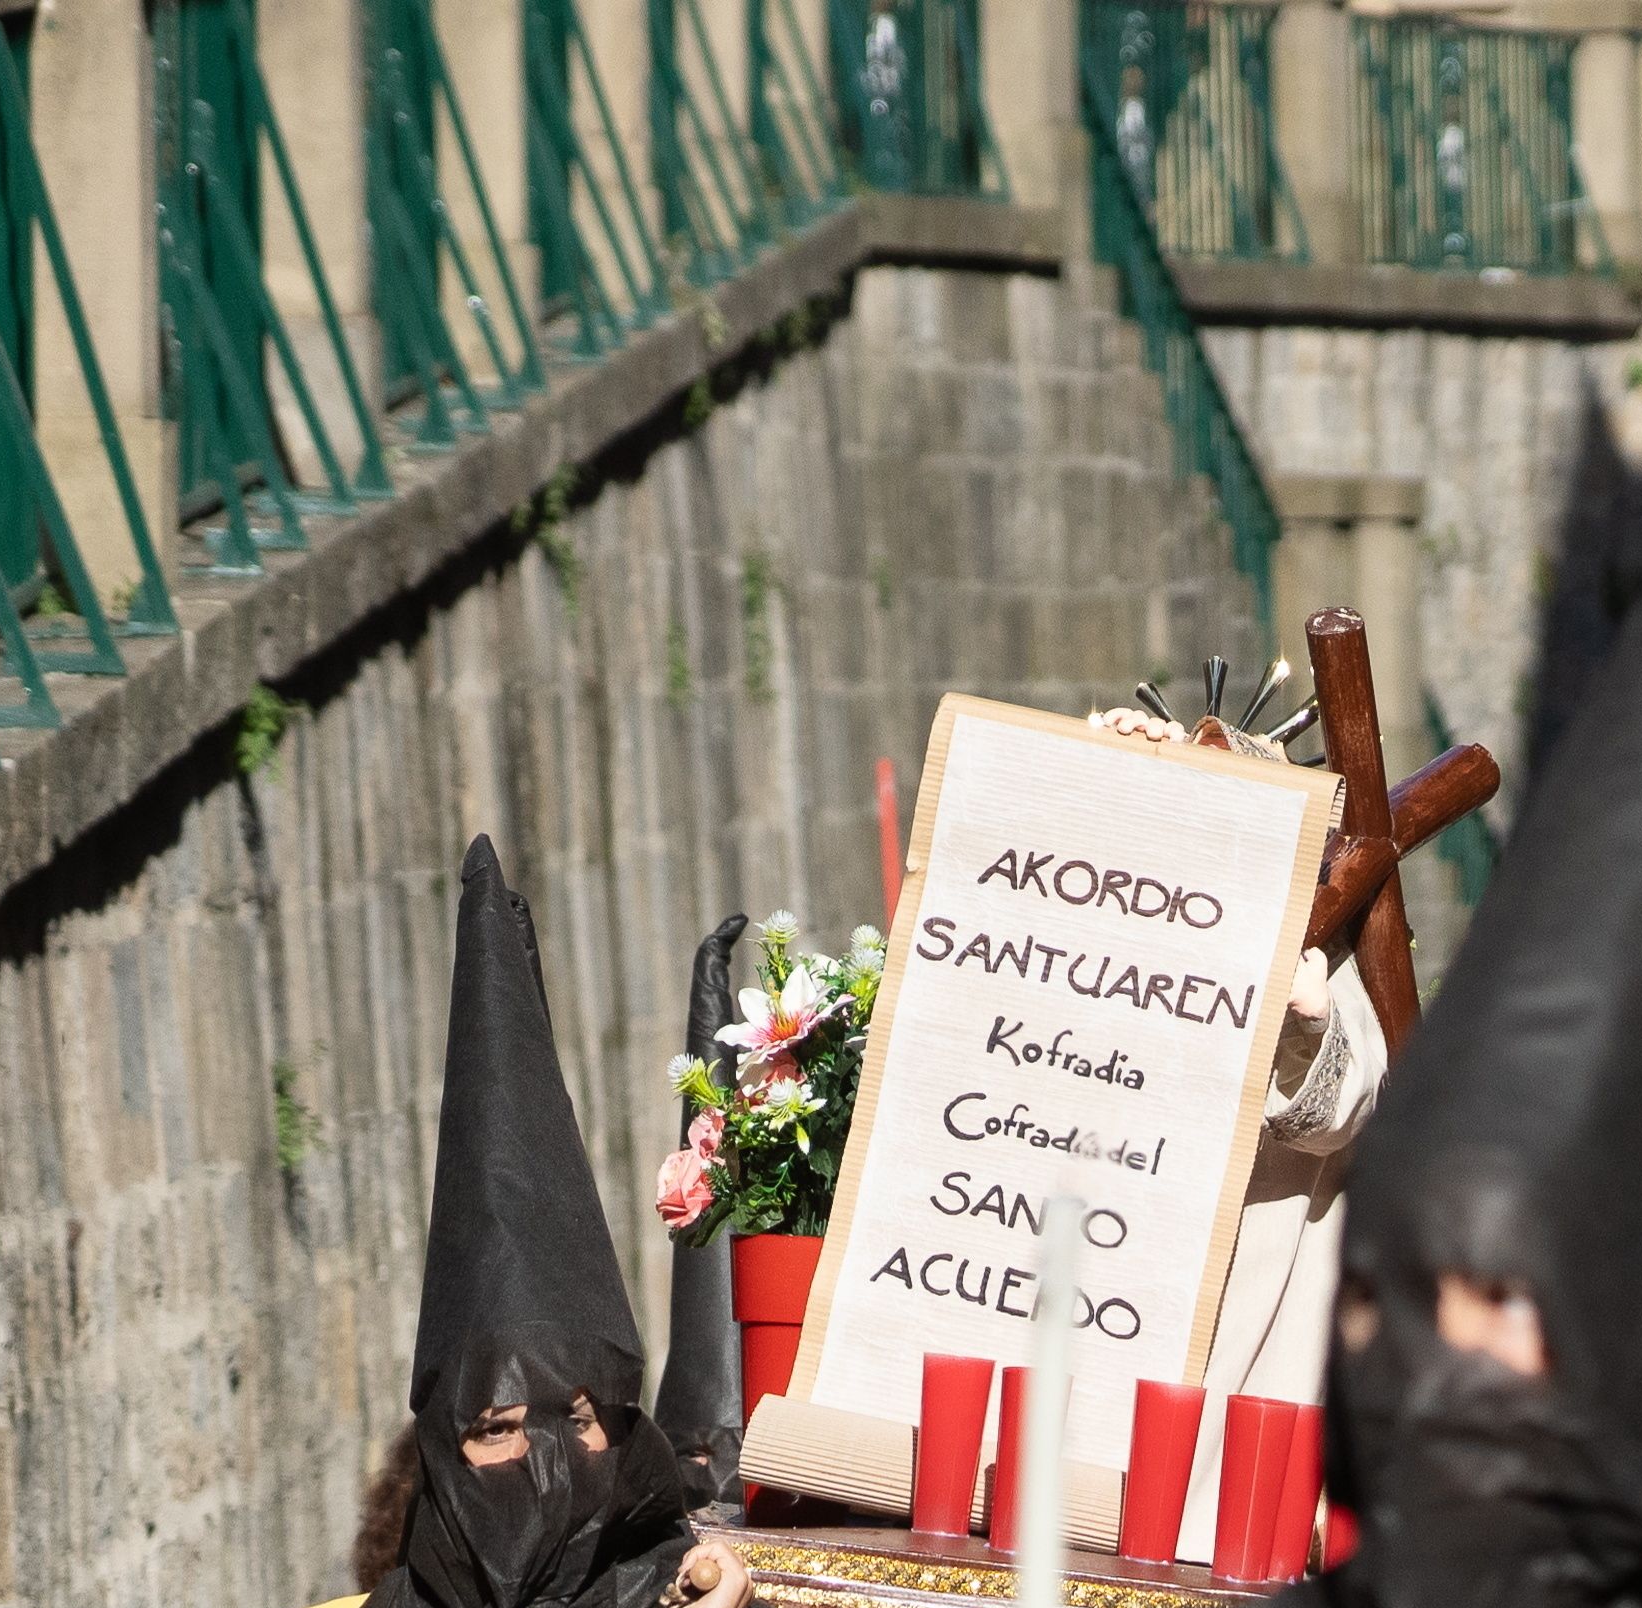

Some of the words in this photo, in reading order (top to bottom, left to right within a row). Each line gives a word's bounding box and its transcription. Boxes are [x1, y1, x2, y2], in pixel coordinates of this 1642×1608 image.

[977, 846, 1223, 931] AKORDIO
[915, 915, 1256, 1031] SANTUAREN
[985, 1015, 1146, 1092] Kofradia
[929, 1170, 1128, 1249] SANO
